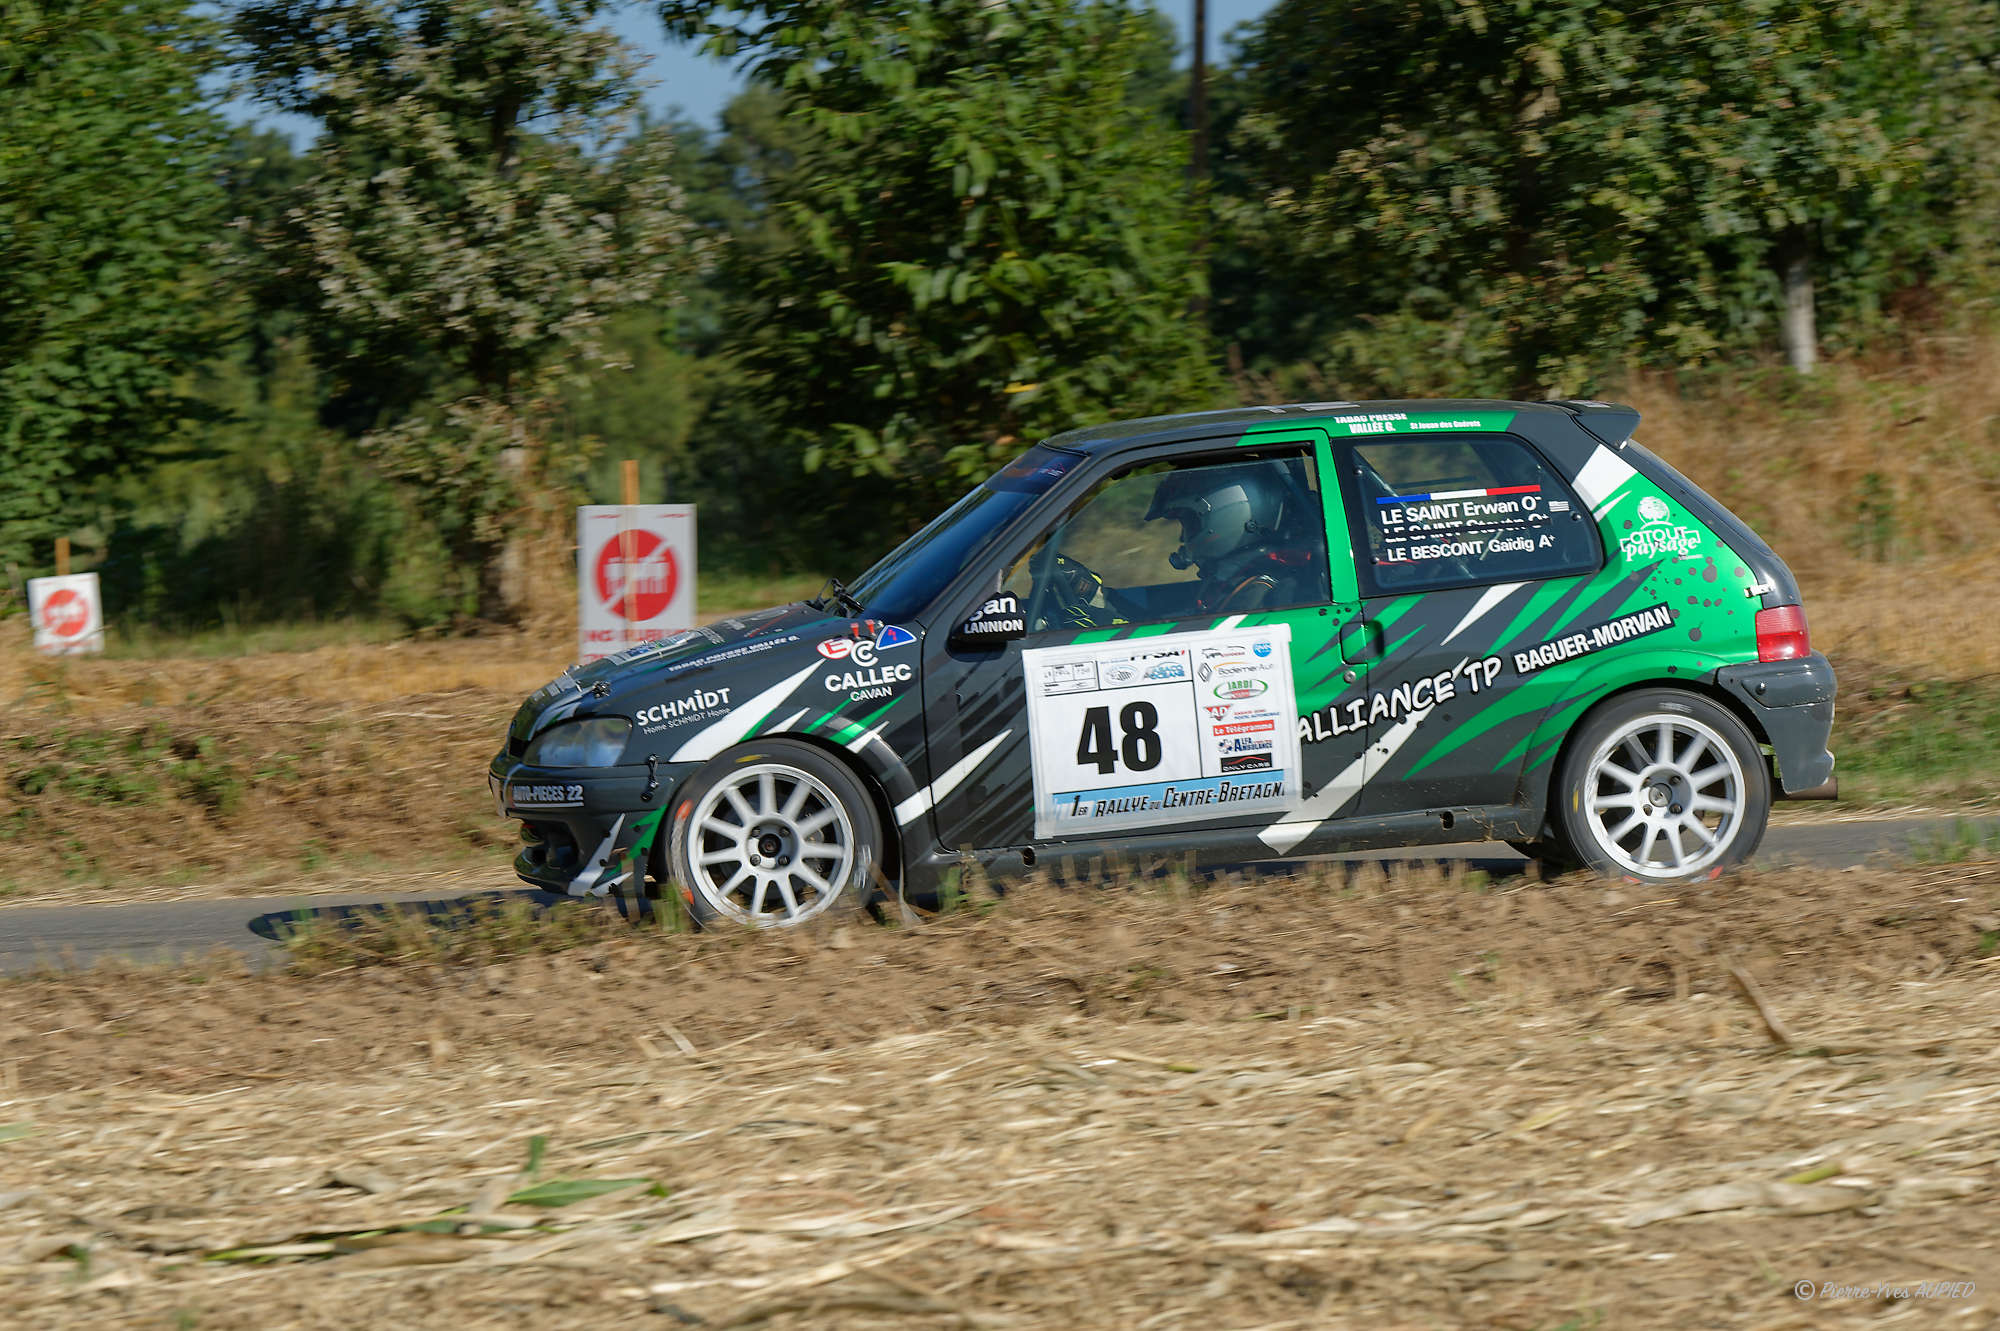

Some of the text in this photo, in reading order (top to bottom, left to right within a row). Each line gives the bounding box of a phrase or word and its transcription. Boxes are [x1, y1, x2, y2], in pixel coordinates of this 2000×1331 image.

[1349, 421, 1384, 434] VALLÉE
[1380, 509, 1405, 525] LE
[1406, 503, 1460, 522] SAINT
[1463, 499, 1519, 517] Erwan
[1387, 548, 1407, 562] LE
[1411, 541, 1483, 560] BESCONT
[1488, 537, 1534, 553] Gaïdig
[1626, 536, 1697, 562] paysage
[964, 619, 1024, 634] LANNION
[1514, 606, 1672, 674] BAGUER-MORVAN
[824, 663, 912, 692] CALLEC
[850, 686, 893, 701] CAVAN
[1298, 656, 1502, 743] ALLIANCE TP
[636, 688, 730, 726] SCHMIDT
[1210, 706, 1227, 718] AD
[643, 707, 731, 735] Home SCHMIDT Home
[1214, 723, 1273, 735] Le Télégramme
[1077, 701, 1162, 775] 48
[567, 785, 584, 800] 22
[1095, 796, 1149, 818] RALLYE
